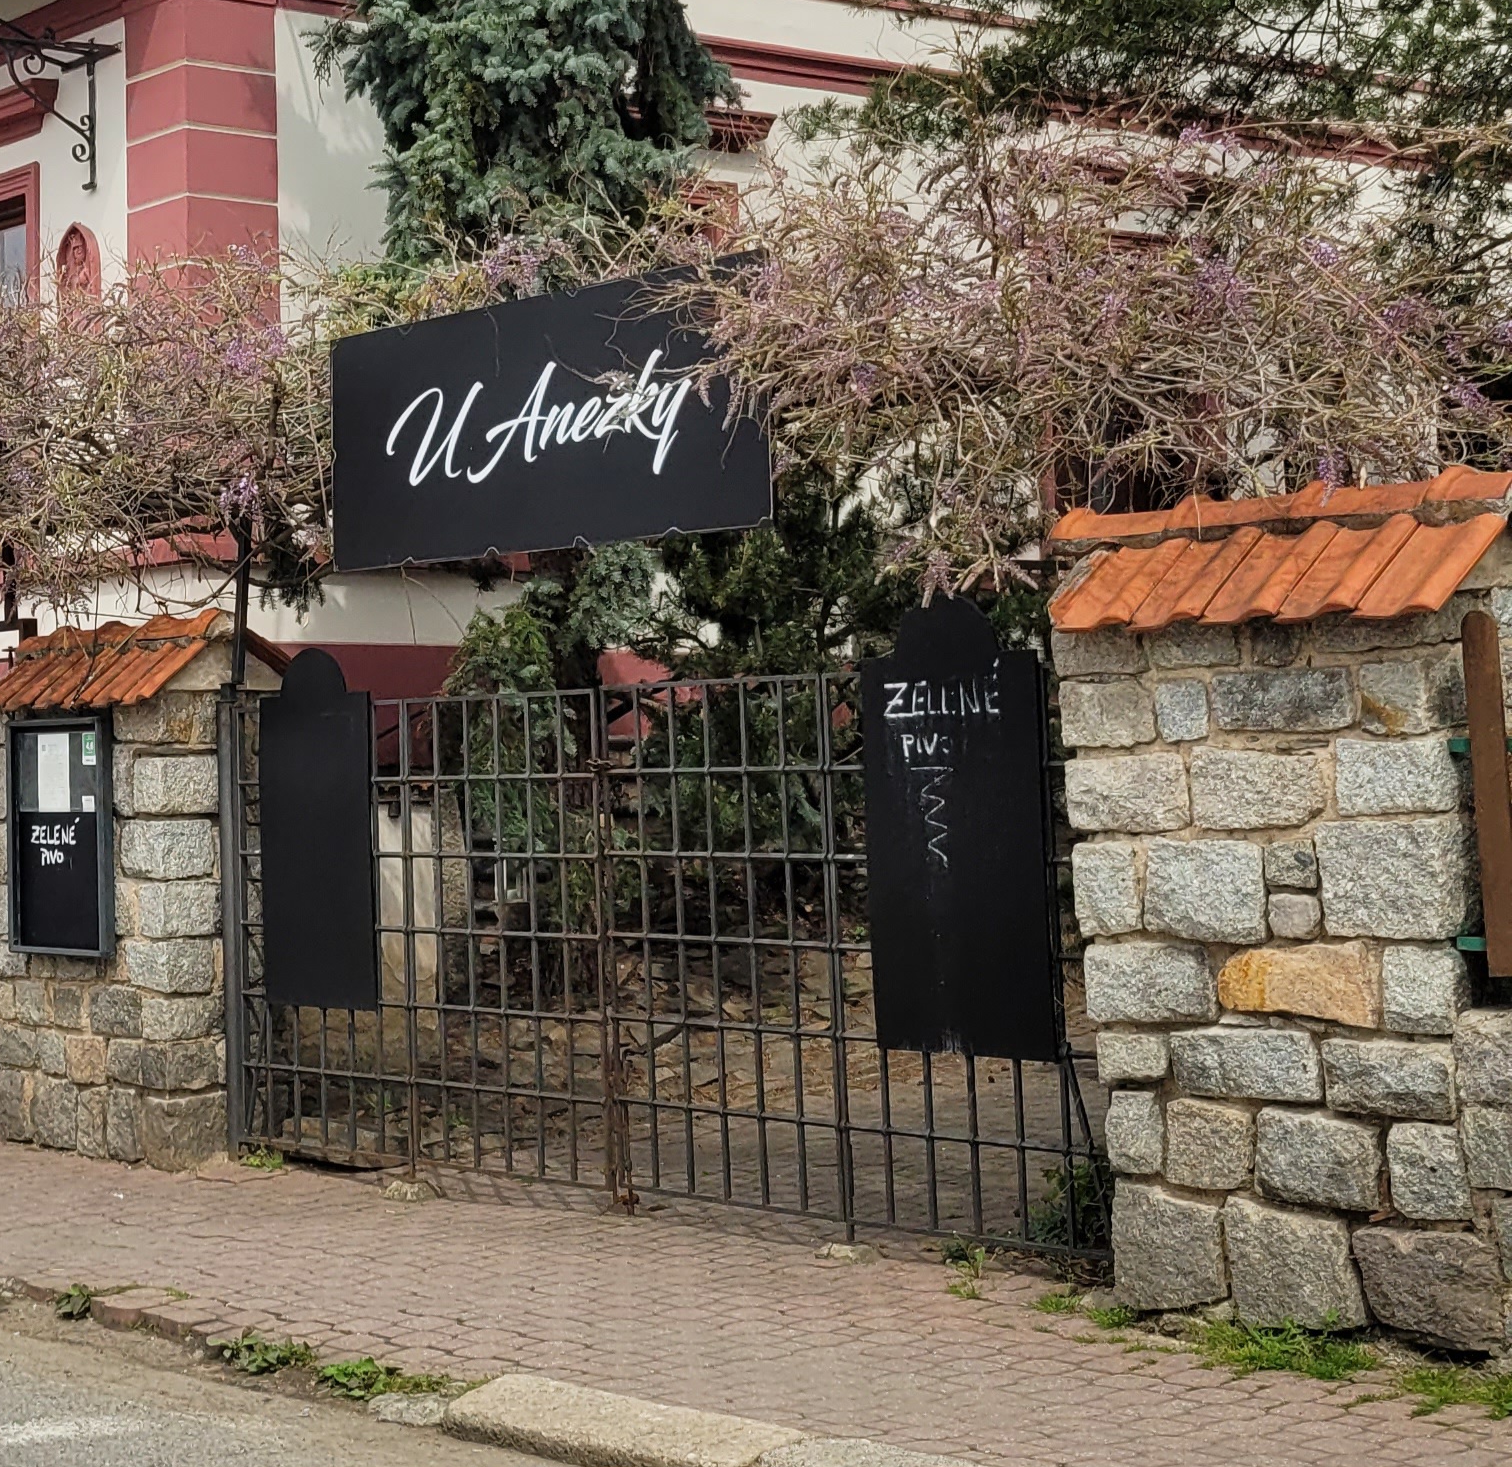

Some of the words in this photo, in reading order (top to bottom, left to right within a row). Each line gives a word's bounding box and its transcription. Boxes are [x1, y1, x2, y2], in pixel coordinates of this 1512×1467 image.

[387, 382, 483, 486] U
[31, 817, 80, 845] ZELENÉ
[40, 848, 64, 866] PIVO
